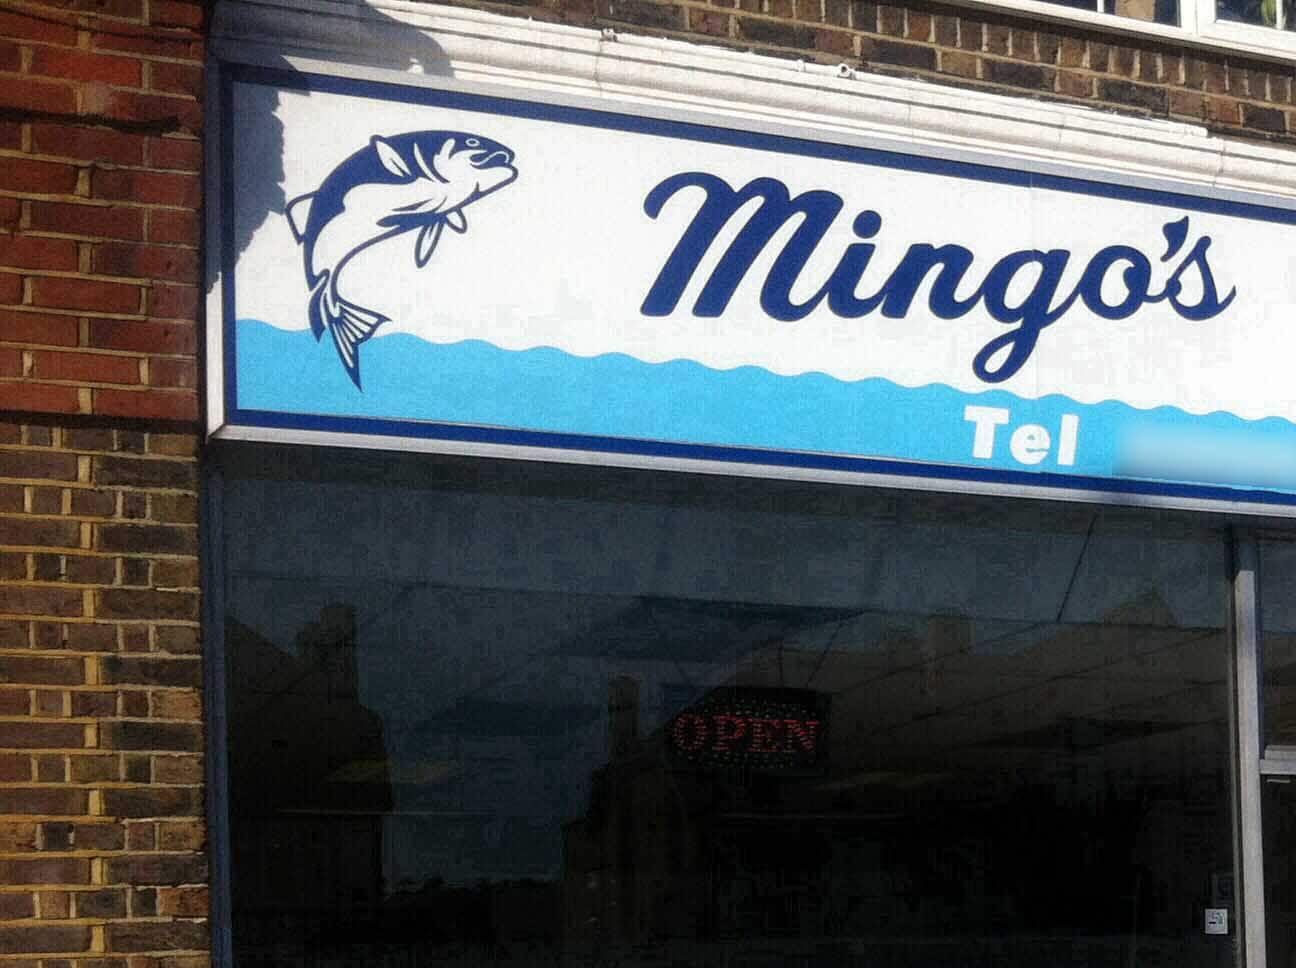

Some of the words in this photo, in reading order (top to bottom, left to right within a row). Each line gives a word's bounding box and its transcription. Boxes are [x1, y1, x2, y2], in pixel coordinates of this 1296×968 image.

[641, 171, 1236, 383] Mingo's
[964, 405, 1079, 466] Tel
[673, 714, 820, 752] OPEN
